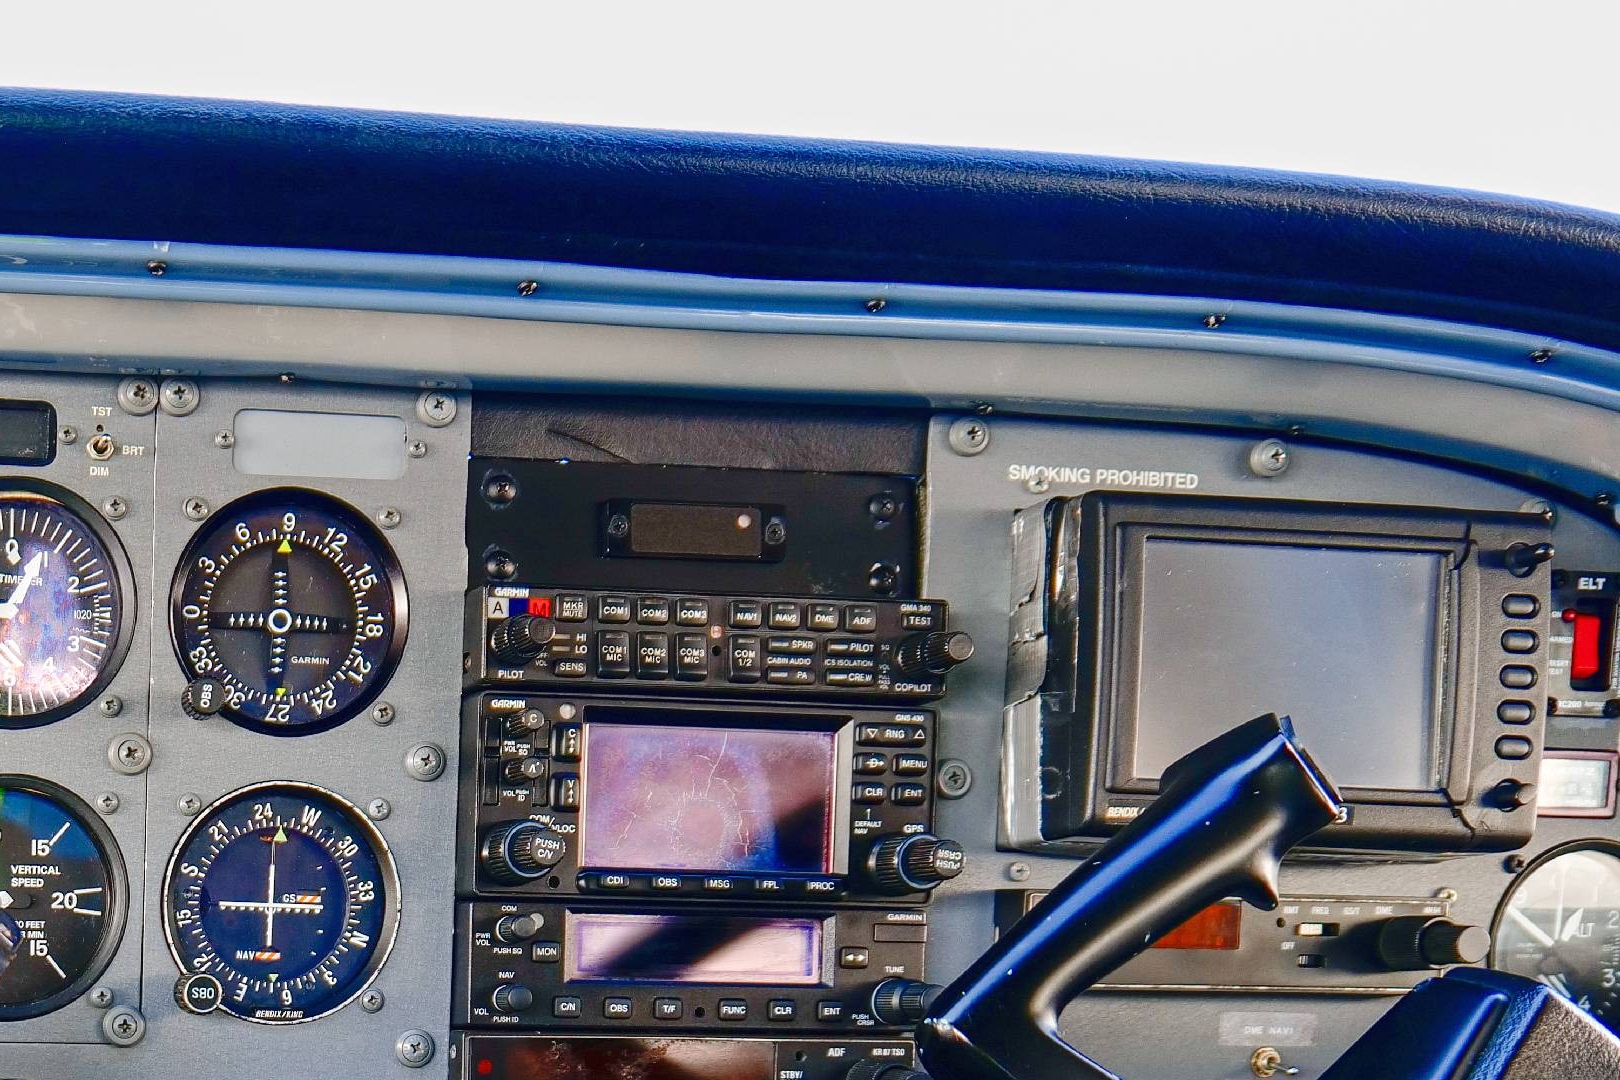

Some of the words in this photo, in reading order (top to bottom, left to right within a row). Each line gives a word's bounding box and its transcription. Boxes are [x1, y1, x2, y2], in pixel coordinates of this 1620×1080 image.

[92, 407, 112, 416] TST
[122, 446, 144, 455] BRT
[90, 467, 109, 476] DIM
[1009, 465, 1091, 484] SMOKING
[1096, 469, 1198, 488] PROHIBITED
[282, 513, 295, 532] 9
[1578, 578, 1606, 591] ELT
[495, 588, 529, 597] GARMIN
[604, 606, 628, 615] COM1
[642, 609, 667, 617] COM2
[681, 608, 707, 621] COM3
[737, 611, 757, 621] NAV1
[776, 612, 797, 623] NAV2
[815, 613, 834, 623] DME
[853, 615, 872, 625] ADF
[909, 617, 931, 625] TEST
[791, 640, 813, 649] SPKR
[850, 643, 874, 651] PILOT
[291, 656, 329, 665] GARMIN
[499, 670, 524, 678] PILOT
[895, 684, 932, 692] COPILOT
[902, 759, 927, 768] MENU
[903, 824, 924, 834] GPS
[11, 866, 61, 875] VERTICAL
[11, 879, 44, 887] SPEED
[607, 876, 623, 885] CDI
[658, 878, 677, 887] OBS
[710, 879, 730, 889] MSG
[763, 880, 779, 889] FPL
[811, 881, 834, 891] PROC
[51, 893, 77, 909] 20
[237, 951, 254, 960] NAV
[537, 948, 556, 957] MON
[561, 1002, 576, 1011] C/N
[723, 1006, 746, 1015] FUNC
[828, 1048, 845, 1057] ADF
